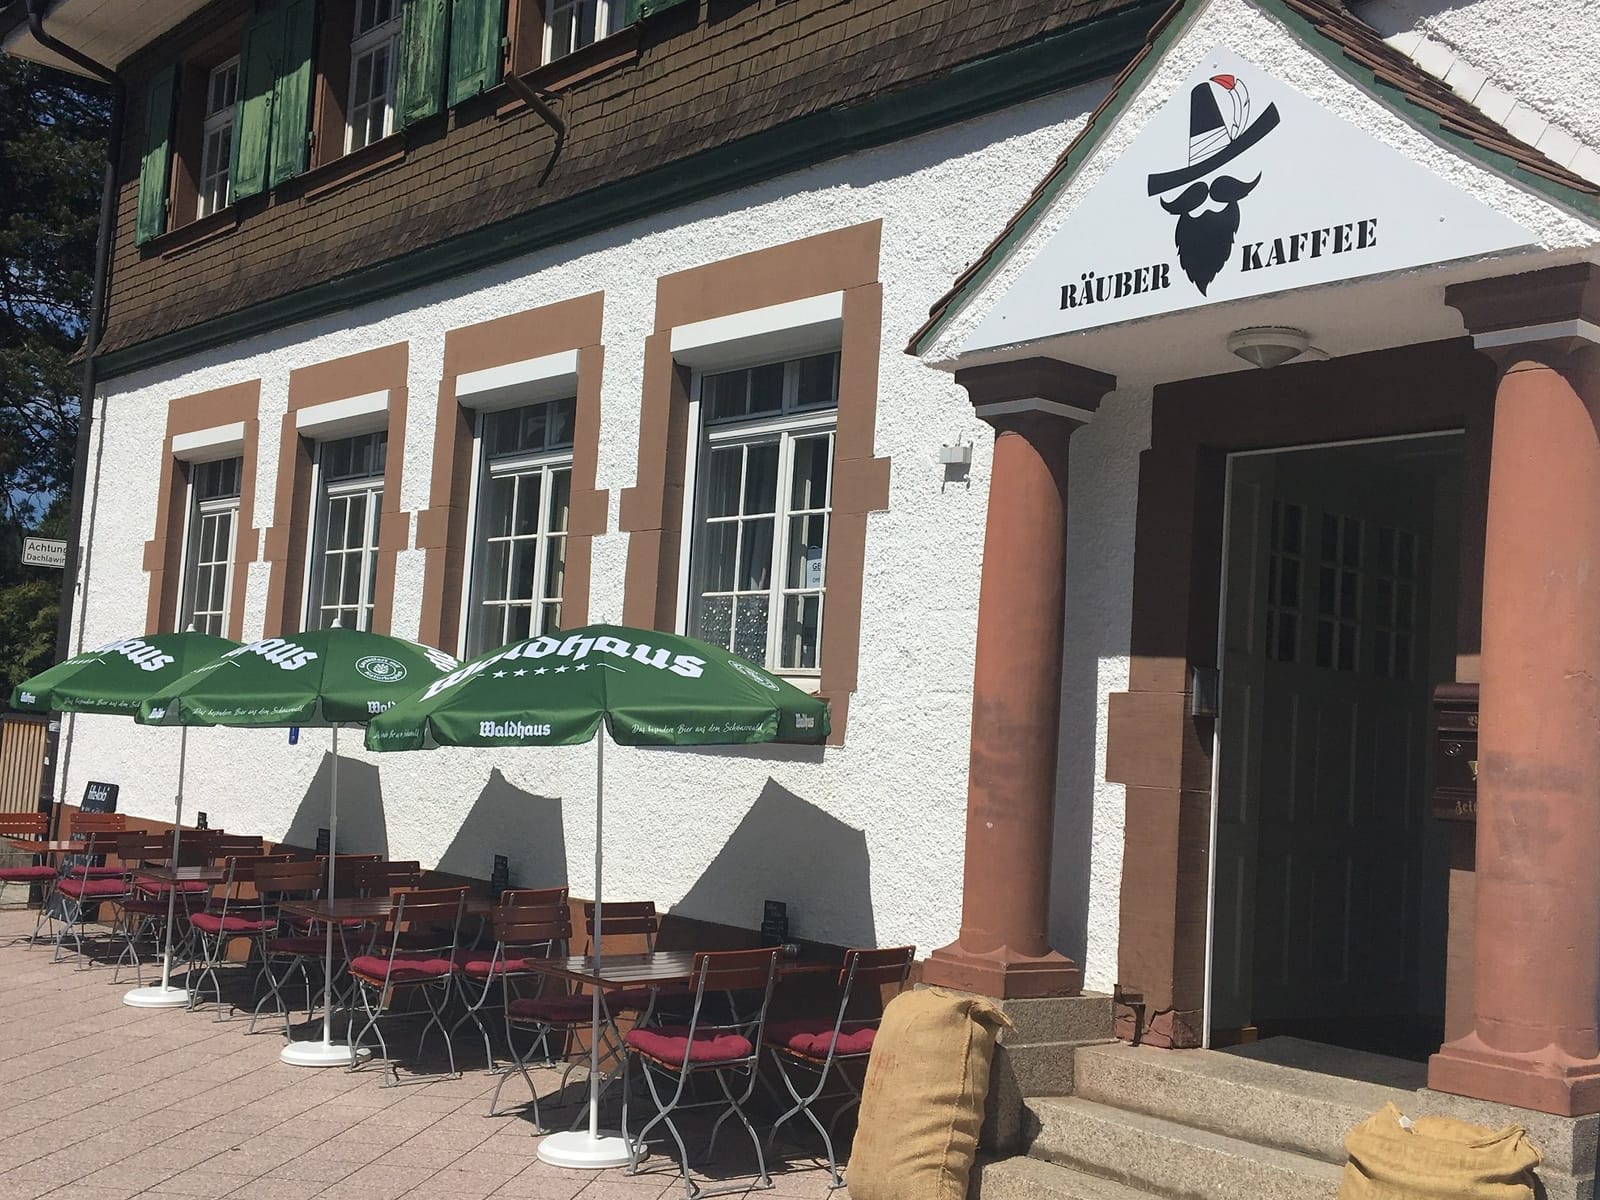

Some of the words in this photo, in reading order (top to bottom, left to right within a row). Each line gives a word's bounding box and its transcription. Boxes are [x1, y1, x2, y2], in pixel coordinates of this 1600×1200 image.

[1059, 263, 1171, 310] RÄUBER
[1240, 218, 1378, 272] KAFFEE
[418, 634, 706, 702] Waldhaus
[479, 721, 551, 739] Waldhaus
